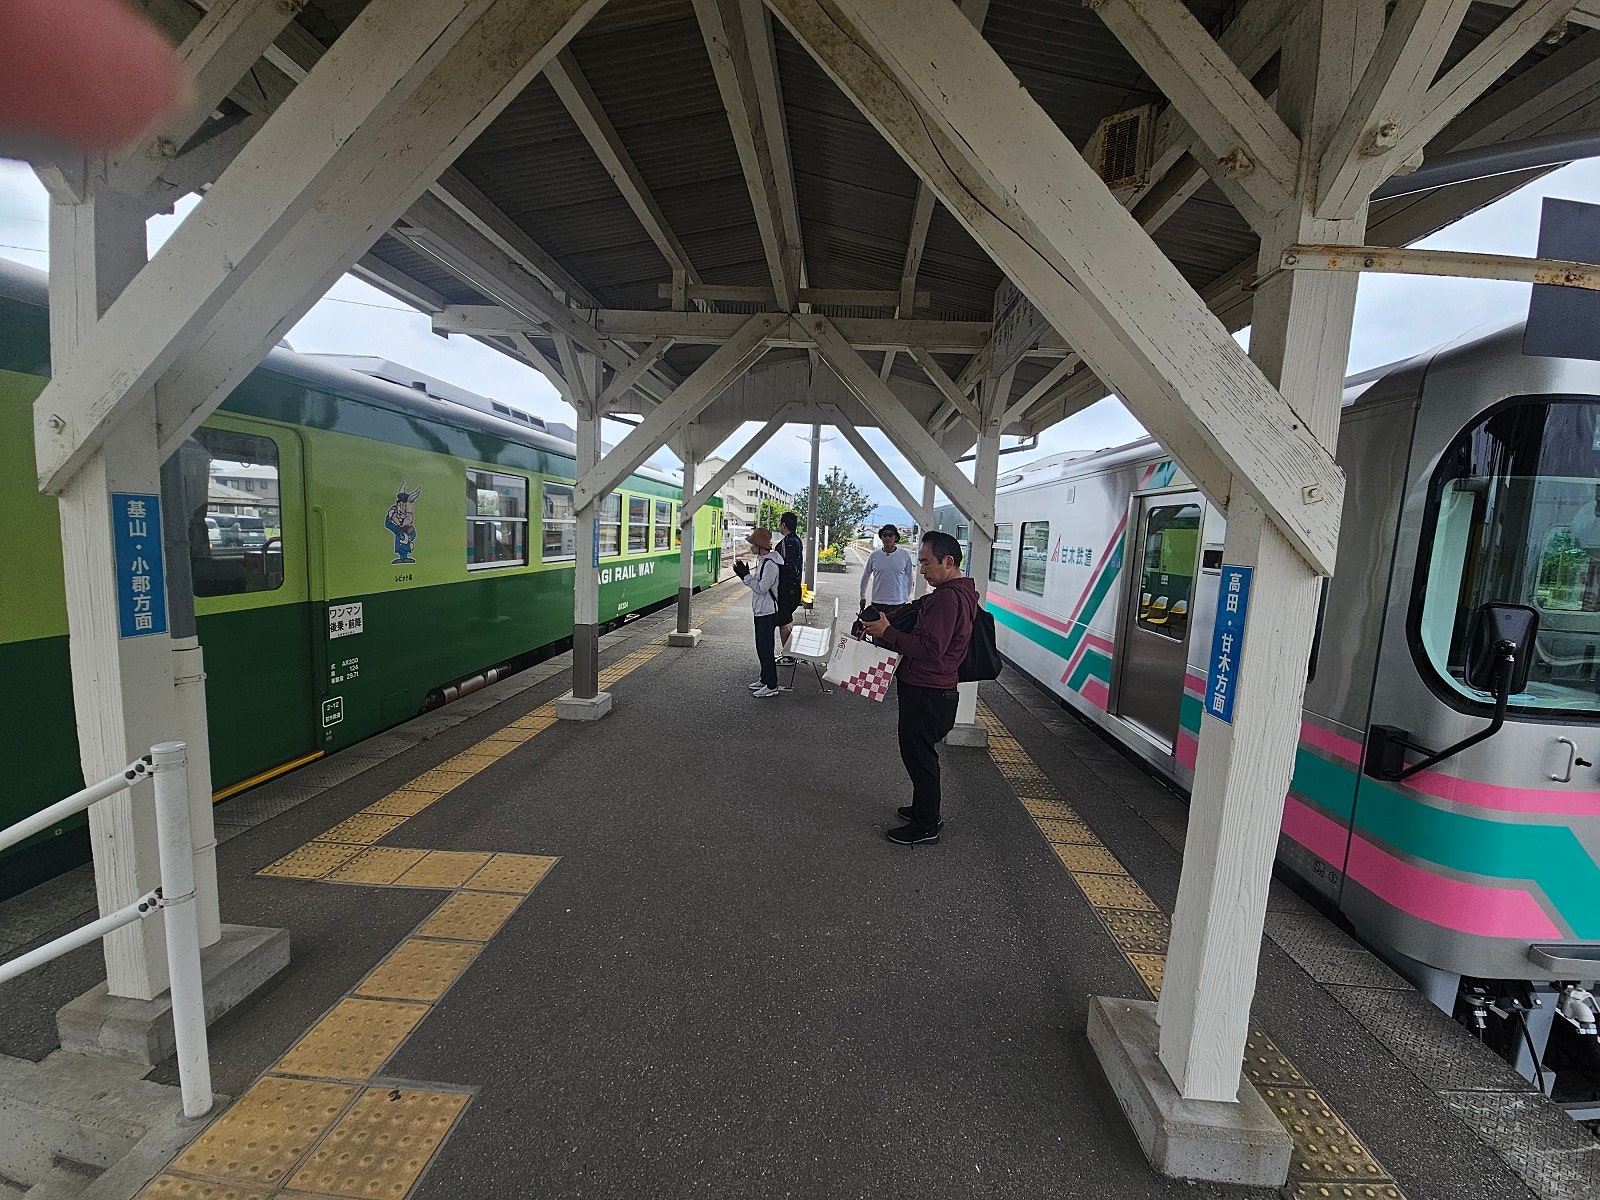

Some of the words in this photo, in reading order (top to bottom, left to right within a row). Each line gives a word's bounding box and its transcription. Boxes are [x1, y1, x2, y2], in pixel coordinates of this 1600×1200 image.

[127, 500, 153, 631] 基山・小郡方面
[1061, 545, 1093, 567] 甘木鉄道
[614, 565, 636, 582] RAIL
[638, 562, 655, 576] WAY
[329, 606, 361, 619] ワンマン
[1212, 572, 1243, 714] 高田・甘木方面
